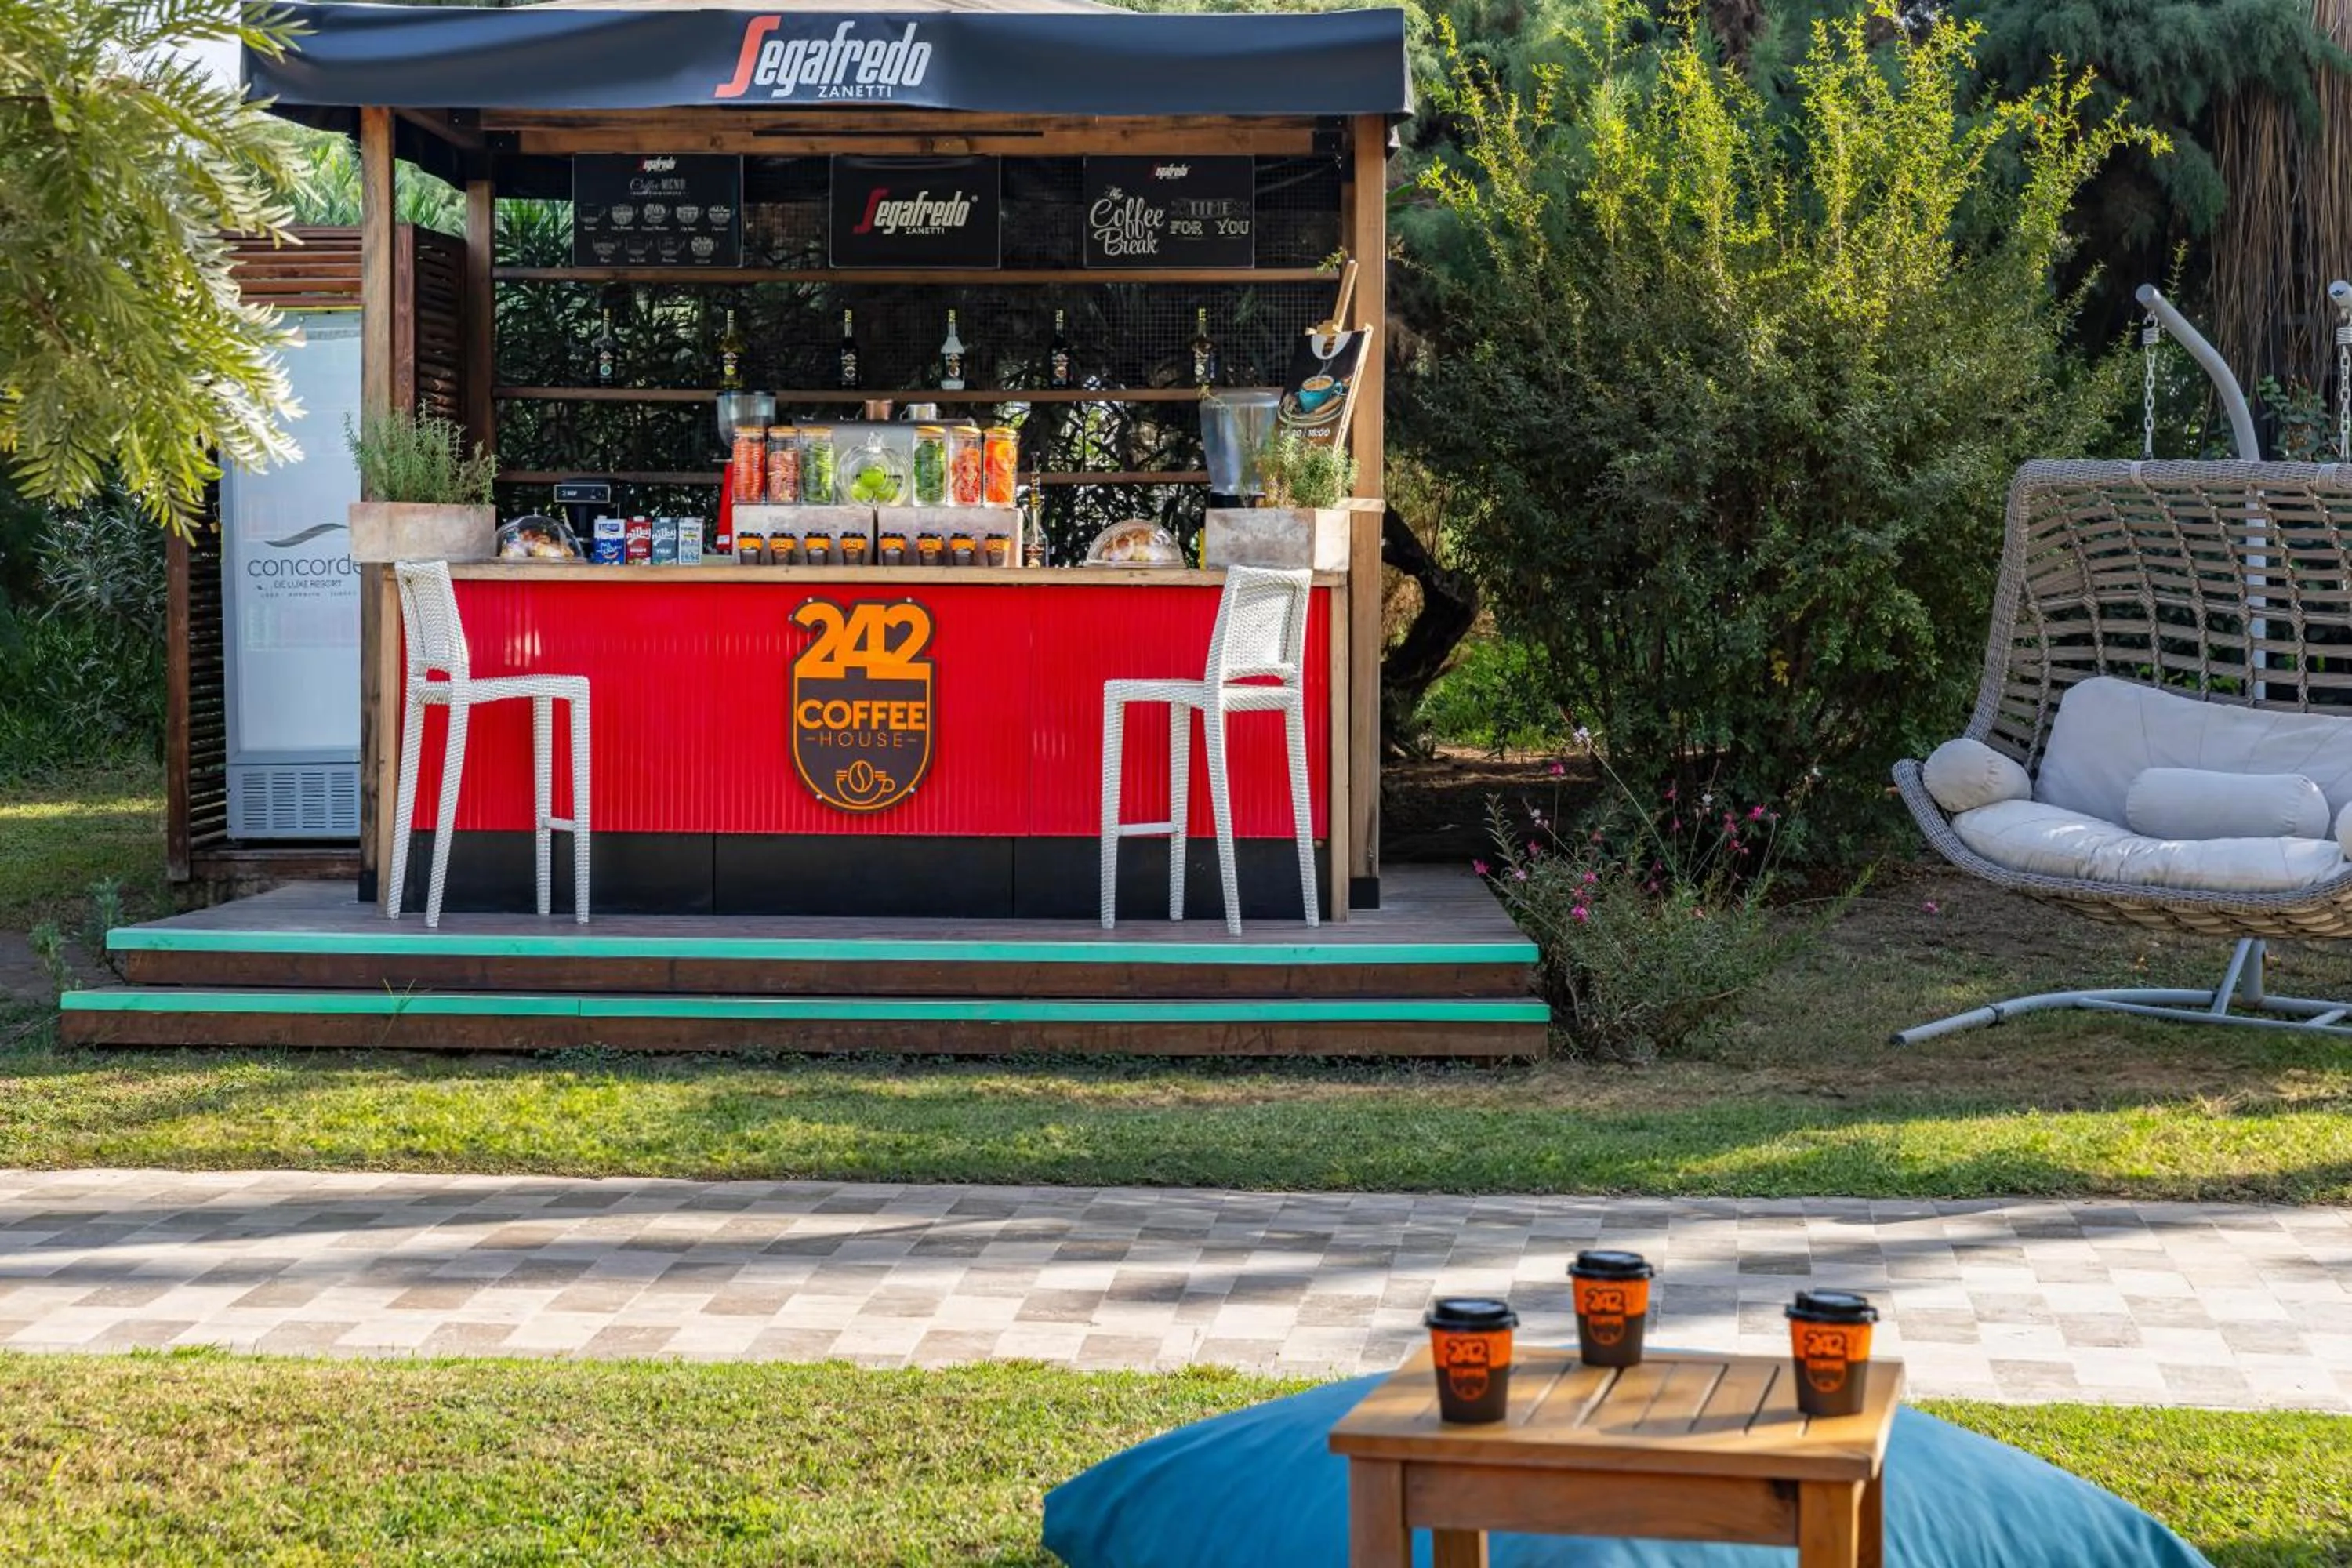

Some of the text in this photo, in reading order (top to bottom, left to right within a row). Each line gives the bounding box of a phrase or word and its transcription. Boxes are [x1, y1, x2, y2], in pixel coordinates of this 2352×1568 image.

[714, 15, 932, 98] Segafredo
[818, 85, 892, 98] ZANETTI
[852, 187, 971, 234] Segafredo
[1089, 197, 1165, 239] Coffee
[1169, 217, 1250, 235] FOR YOU
[1094, 227, 1160, 256] Break
[794, 602, 931, 680] 242
[797, 699, 927, 730] COFFEE
[819, 731, 902, 747] HOUSE
[1586, 1289, 1624, 1312] 242
[1447, 1341, 1486, 1362] 242
[1804, 1333, 1845, 1355] 242
